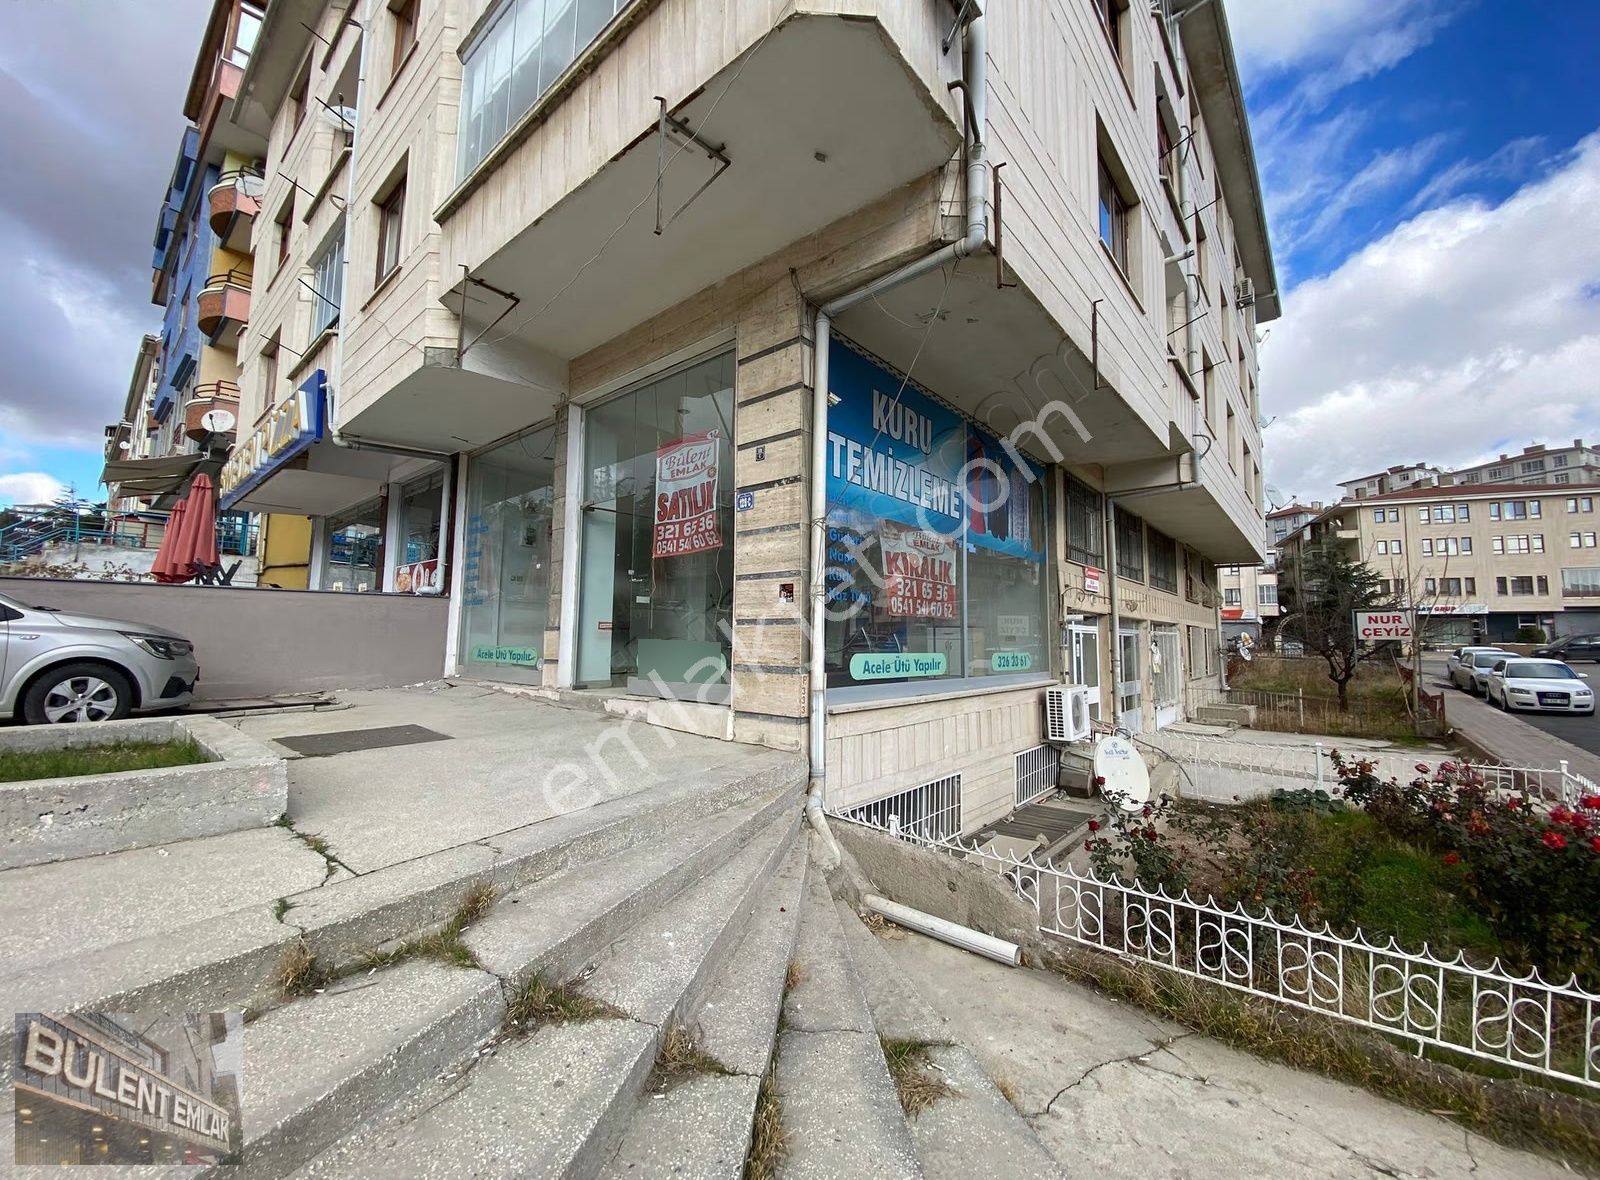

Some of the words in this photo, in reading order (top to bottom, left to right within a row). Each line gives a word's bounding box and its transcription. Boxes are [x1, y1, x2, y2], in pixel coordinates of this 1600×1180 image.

[872, 389, 932, 455] KURU
[666, 448, 711, 470] Bülent
[671, 460, 707, 479] EMLAK
[829, 431, 960, 520] TEMİZLEME
[657, 479, 716, 523] SATILIK
[658, 524, 680, 540] 321
[683, 521, 698, 536] 65
[699, 514, 714, 532] 36
[656, 540, 676, 554] 0541
[693, 532, 705, 549] 60
[705, 530, 719, 546] 62
[885, 550, 952, 585] KIRALIK
[897, 577, 917, 597] 321
[921, 582, 933, 600] 65
[936, 585, 948, 602] 36
[891, 596, 913, 613] 0541
[930, 602, 942, 616] 60
[943, 603, 953, 617] 62
[1368, 615, 1402, 625] NUR
[1362, 627, 1411, 639] ÇEYİZ
[476, 648, 494, 659] Acele
[495, 646, 507, 660] Ütü
[998, 656, 1010, 668] 326
[863, 660, 891, 674] Acele
[894, 655, 911, 673] Ütü
[913, 658, 941, 674] Yapılır
